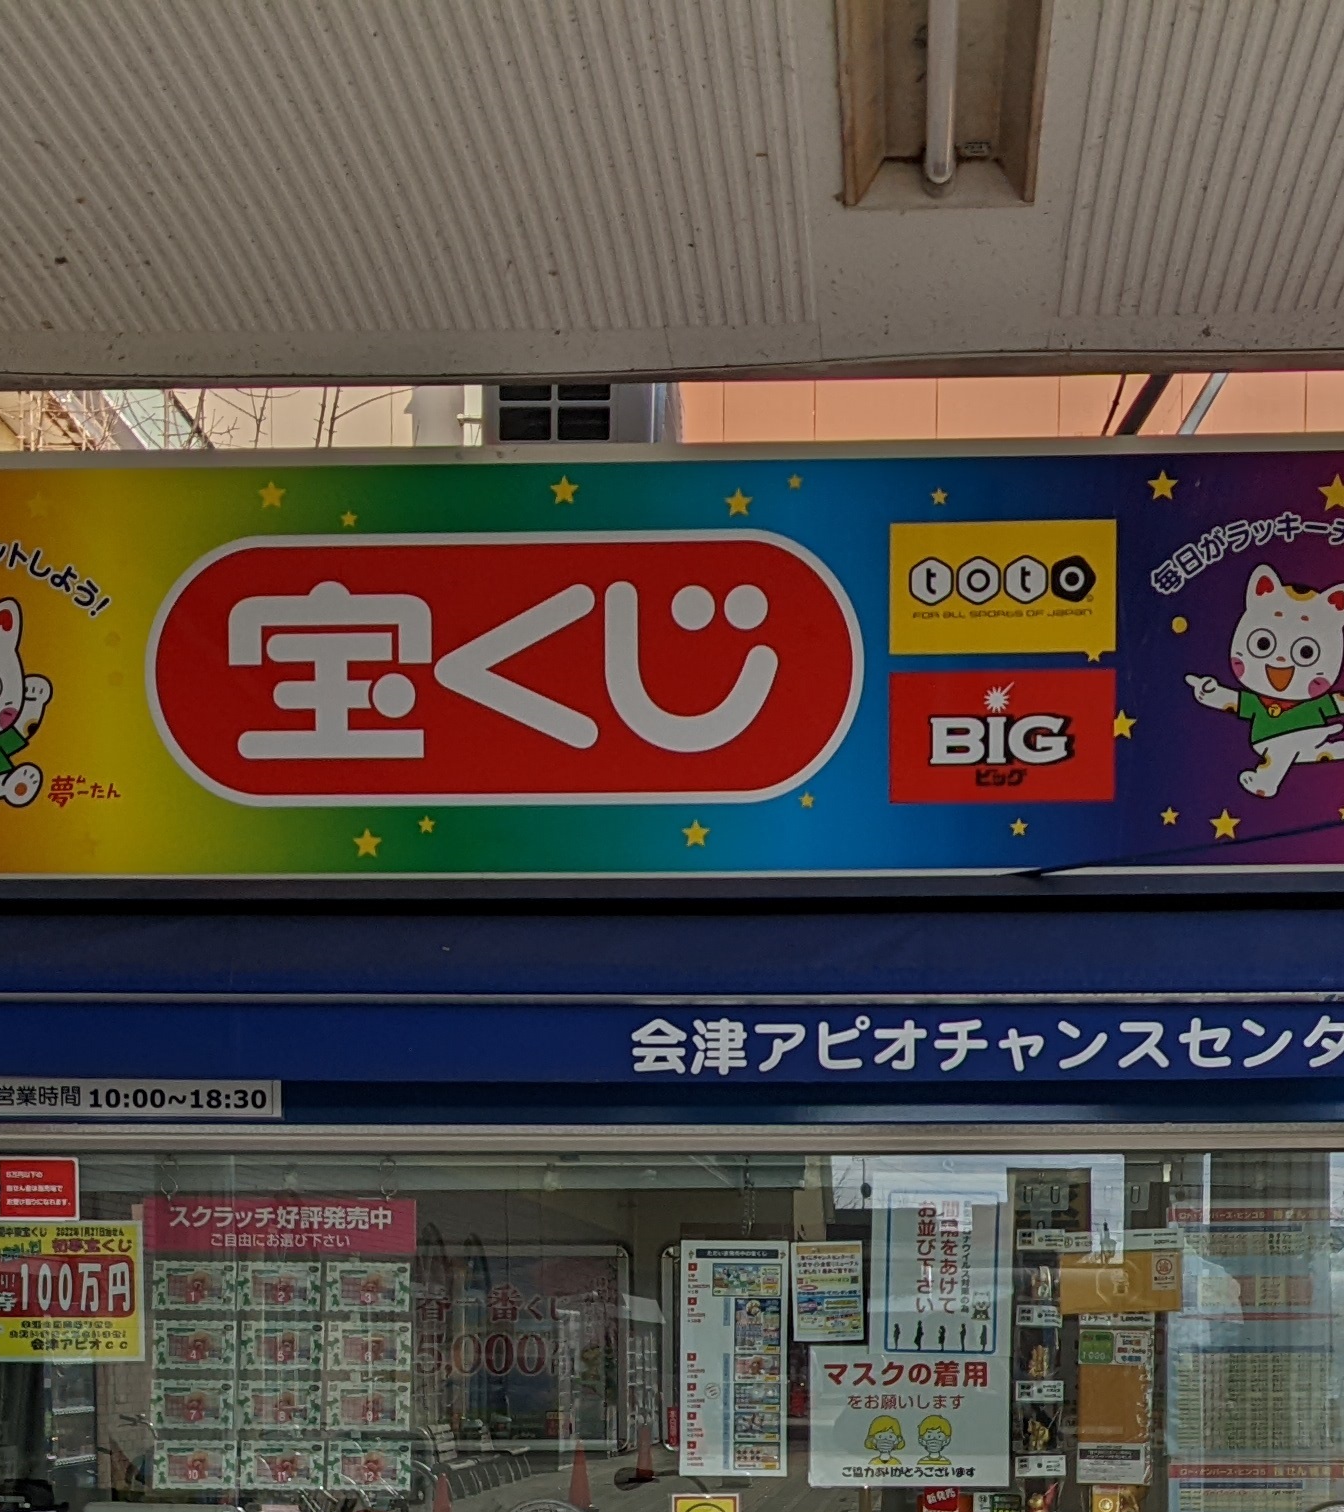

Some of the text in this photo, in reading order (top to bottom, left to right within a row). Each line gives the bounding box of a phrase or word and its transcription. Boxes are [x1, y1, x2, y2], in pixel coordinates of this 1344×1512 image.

[908, 554, 1097, 606] toto
[228, 580, 779, 760] 宝くじ
[929, 712, 1075, 768] BIG
[975, 768, 1026, 787] ビッグ
[170, 1207, 392, 1230] スクラッチ好評発売中
[210, 1233, 350, 1248] ご自由にお選び下さい
[916, 1199, 937, 1314] お並び下さい
[20, 1261, 131, 1313] 100万円
[824, 1361, 989, 1389] マスクの着用
[847, 1394, 966, 1411] をお願いします
[842, 1465, 977, 1480] ご協力ありがとうございます
